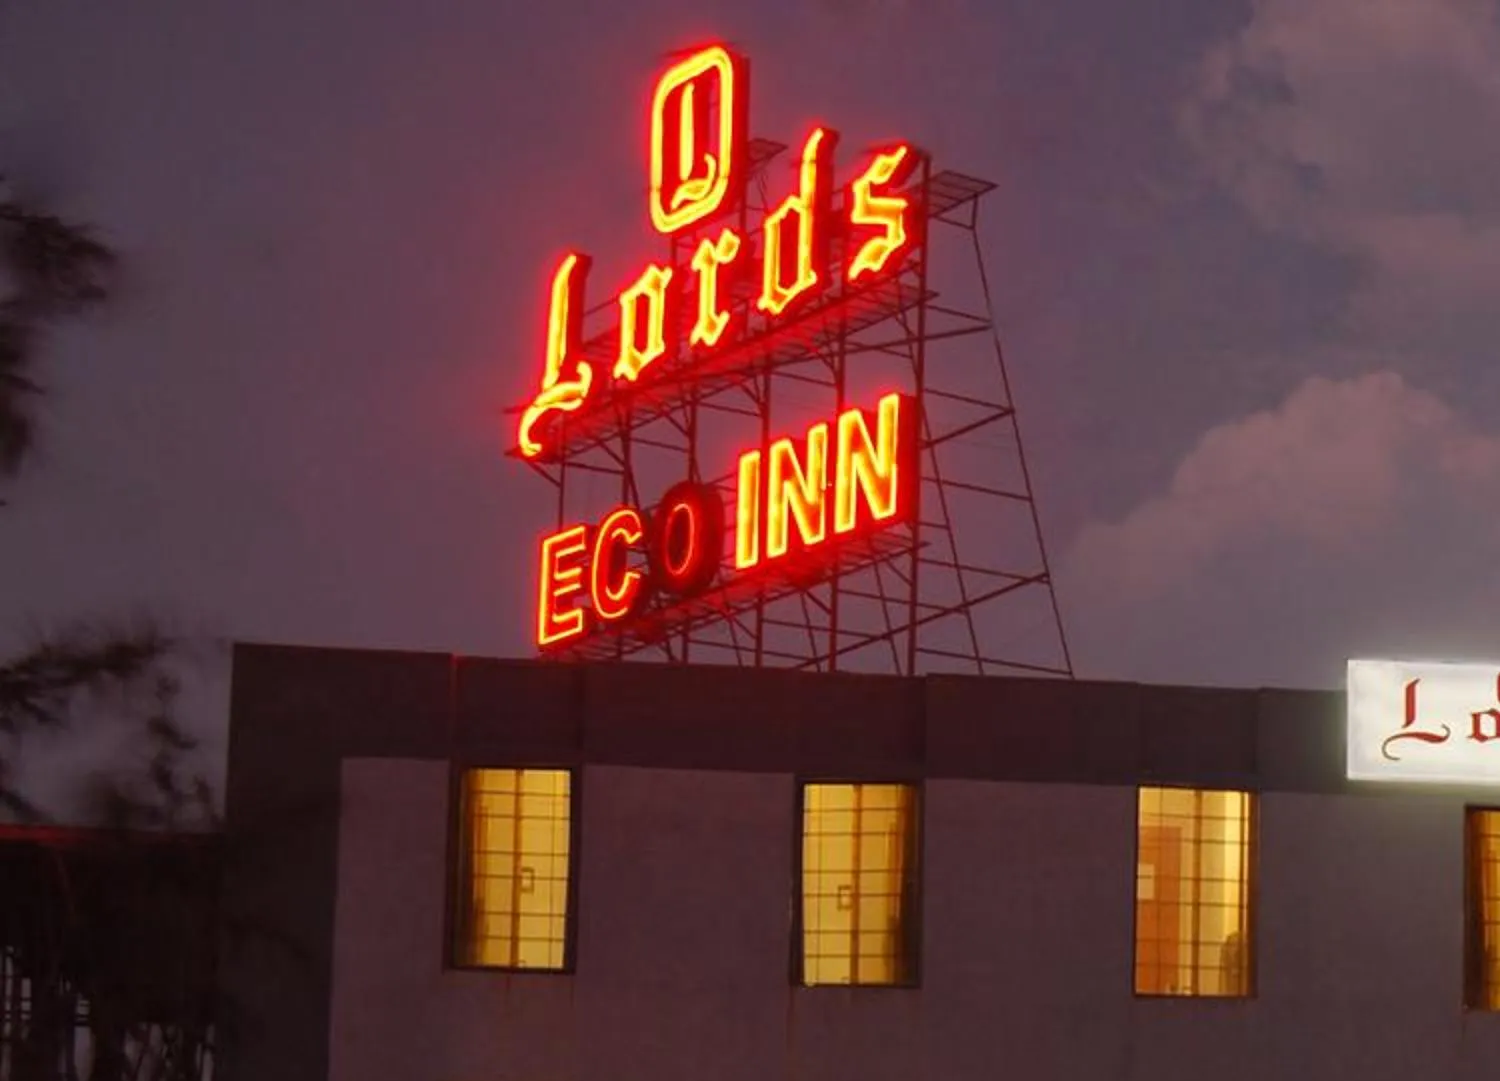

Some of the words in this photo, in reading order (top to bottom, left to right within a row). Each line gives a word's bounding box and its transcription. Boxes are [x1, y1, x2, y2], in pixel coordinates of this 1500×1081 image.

[518, 127, 910, 457] Lords
[537, 492, 724, 646] ECO
[735, 392, 902, 570] INN
